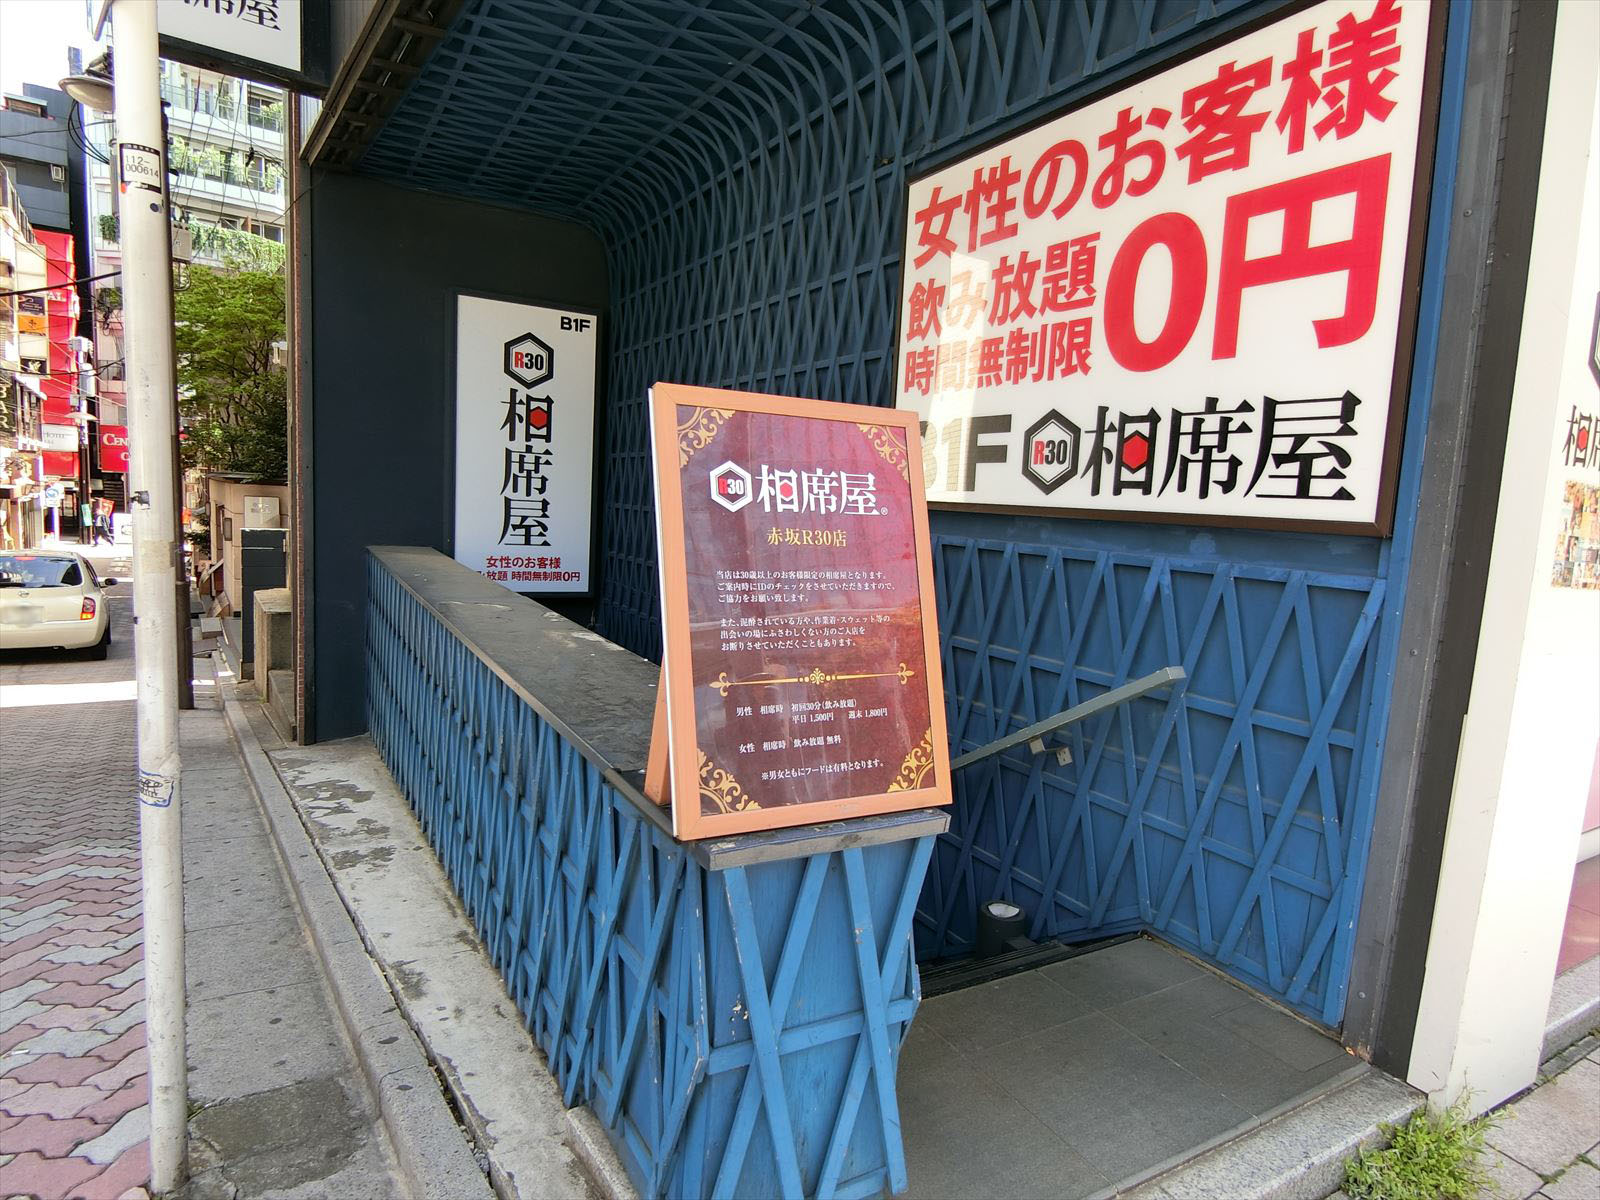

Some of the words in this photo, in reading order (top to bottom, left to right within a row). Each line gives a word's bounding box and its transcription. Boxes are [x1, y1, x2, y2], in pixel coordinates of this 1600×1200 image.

[914, 0, 1403, 268] 女性のお客様
[1104, 152, 1391, 372] 0円
[907, 232, 1100, 342] 飲み放題
[560, 316, 591, 333] B1F
[514, 351, 544, 371] R30
[904, 317, 1092, 395] 時間無制限
[1033, 438, 1067, 465] R30
[1080, 389, 1362, 500] 相席屋
[498, 388, 554, 547] 相席屋
[718, 478, 744, 495] R30
[767, 527, 847, 547] 赤坂R30店
[486, 556, 561, 569] 女性のお客様
[511, 571, 581, 582] 時間無制限0円
[716, 570, 886, 580] 当店は30歳以上のお客様限定の相席屋となります。
[718, 593, 809, 603] ご協力をお願い致します。
[720, 627, 865, 639] 出会いの場にふさわしくない方のご入店を
[721, 638, 856, 651] お断りさせていただくこともあります。
[736, 706, 753, 717] 男性
[760, 704, 784, 715] 相席時
[792, 714, 807, 724] 平日
[848, 710, 863, 719] 週末
[739, 743, 755, 754] 女性
[763, 740, 786, 751] 相席時
[793, 736, 825, 748] 飲み放題
[826, 734, 842, 744] 無料
